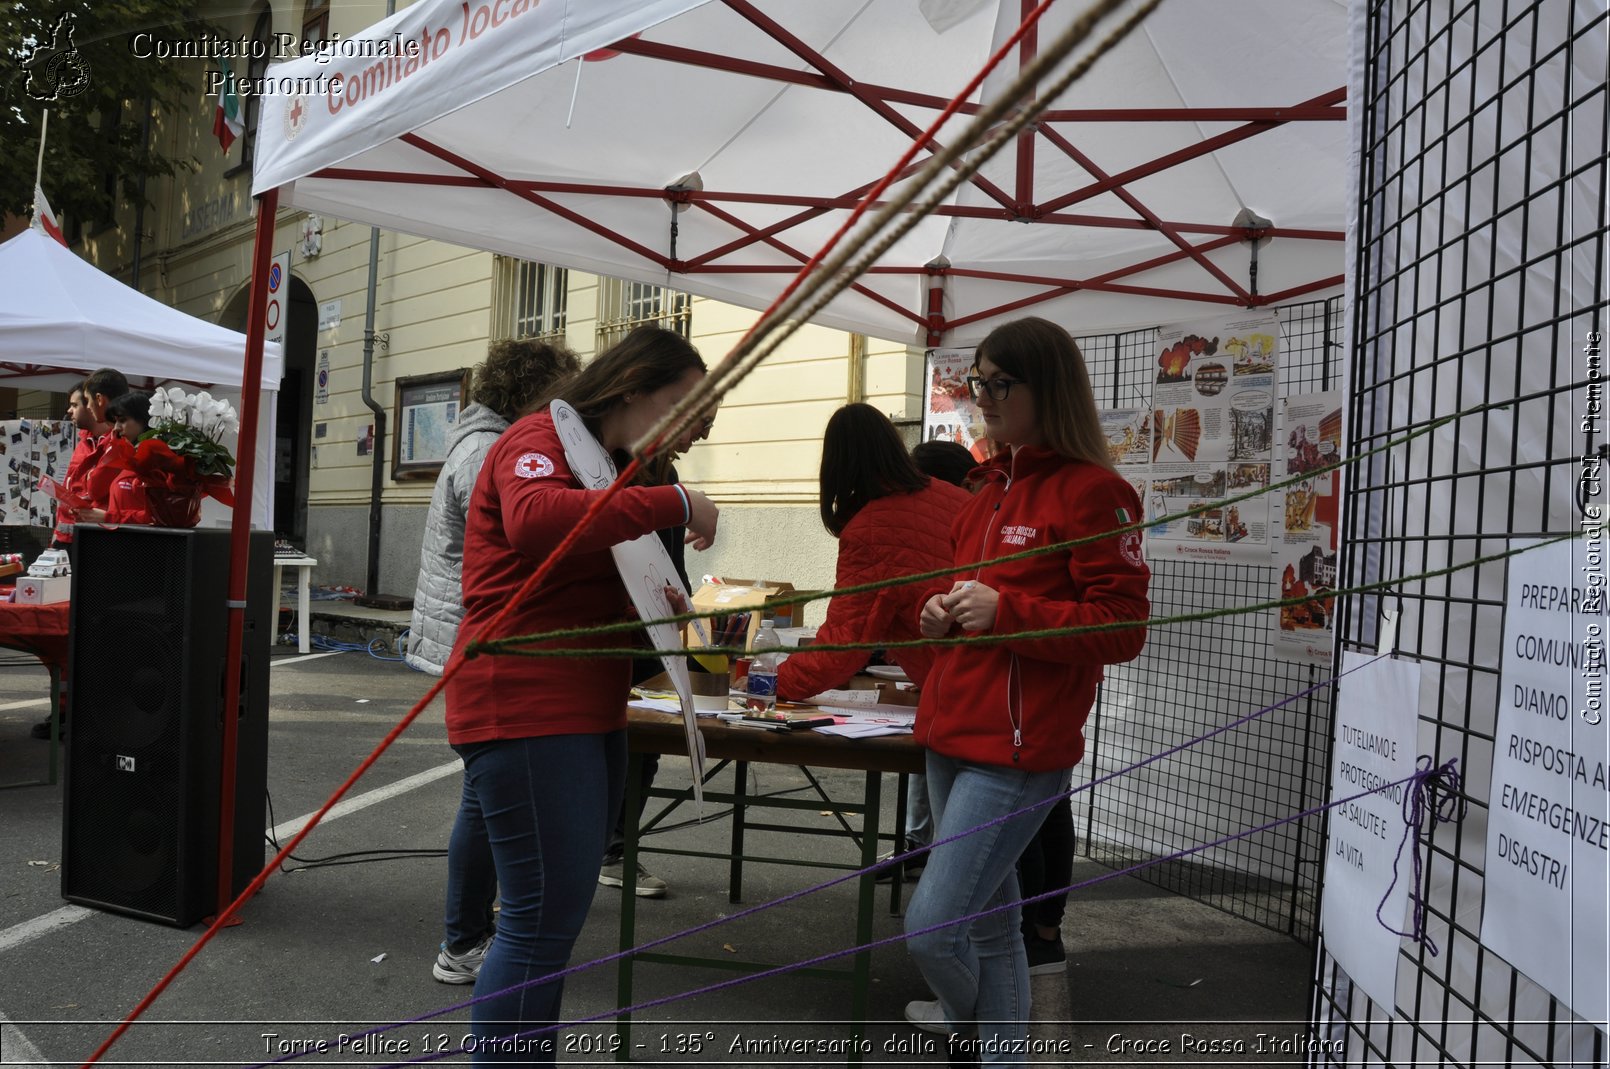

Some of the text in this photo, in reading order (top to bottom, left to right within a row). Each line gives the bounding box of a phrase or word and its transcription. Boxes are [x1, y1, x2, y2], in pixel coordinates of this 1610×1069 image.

[327, 26, 450, 116] Comitato
[1514, 684, 1568, 721] DIAMO
[1342, 724, 1397, 762] TUTELIAMO E
[1508, 734, 1610, 793] RISPOSTA A
[1340, 761, 1402, 806] PROTEGGIAMO
[1349, 803, 1380, 836] SALUTE
[1381, 819, 1387, 840] E
[1501, 783, 1610, 851] EMERGENZE
[1335, 836, 1364, 872] LA VITA
[1498, 832, 1568, 891] DISASTRI
